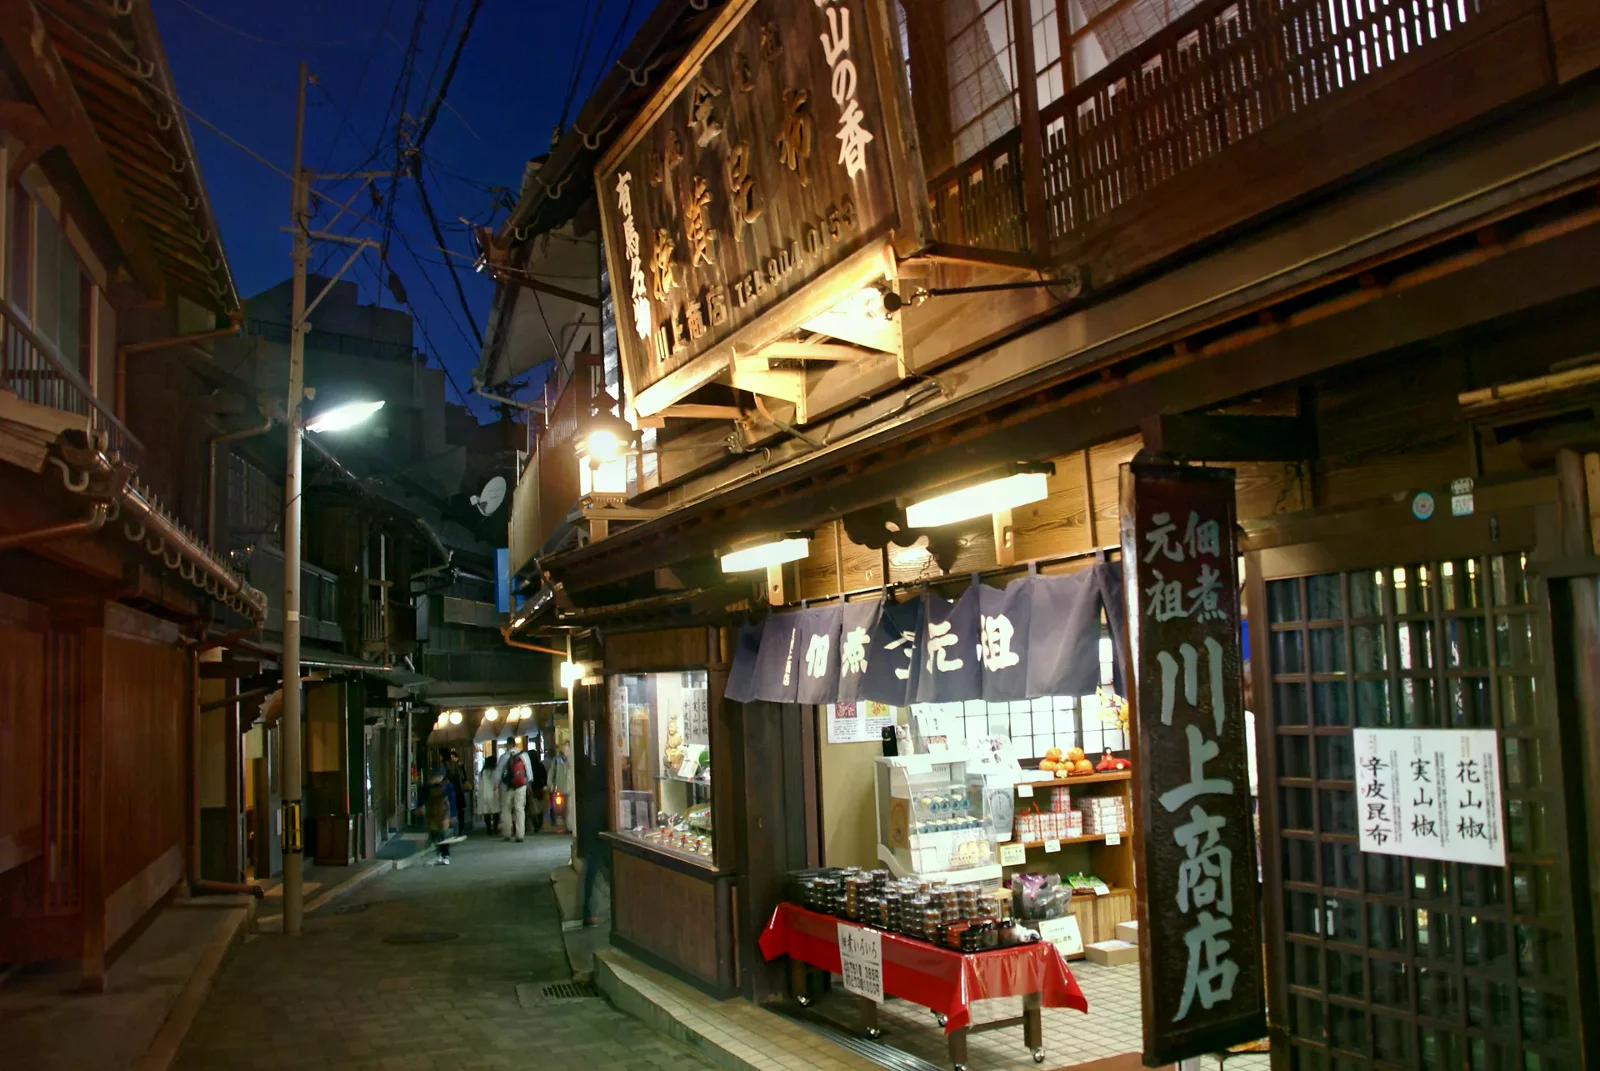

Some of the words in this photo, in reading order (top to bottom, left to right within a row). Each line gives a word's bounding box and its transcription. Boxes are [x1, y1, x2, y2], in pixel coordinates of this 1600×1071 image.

[814, 0, 874, 178] 山の香
[1143, 511, 1188, 622] 元祖
[1184, 510, 1228, 623] 佃煮
[927, 613, 1019, 675] 元祖
[1157, 636, 1240, 1023] 川上商店
[1362, 756, 1391, 847] 辛皮昆布
[1410, 757, 1439, 838] 実山椒
[1456, 759, 1488, 840] 花山椒
